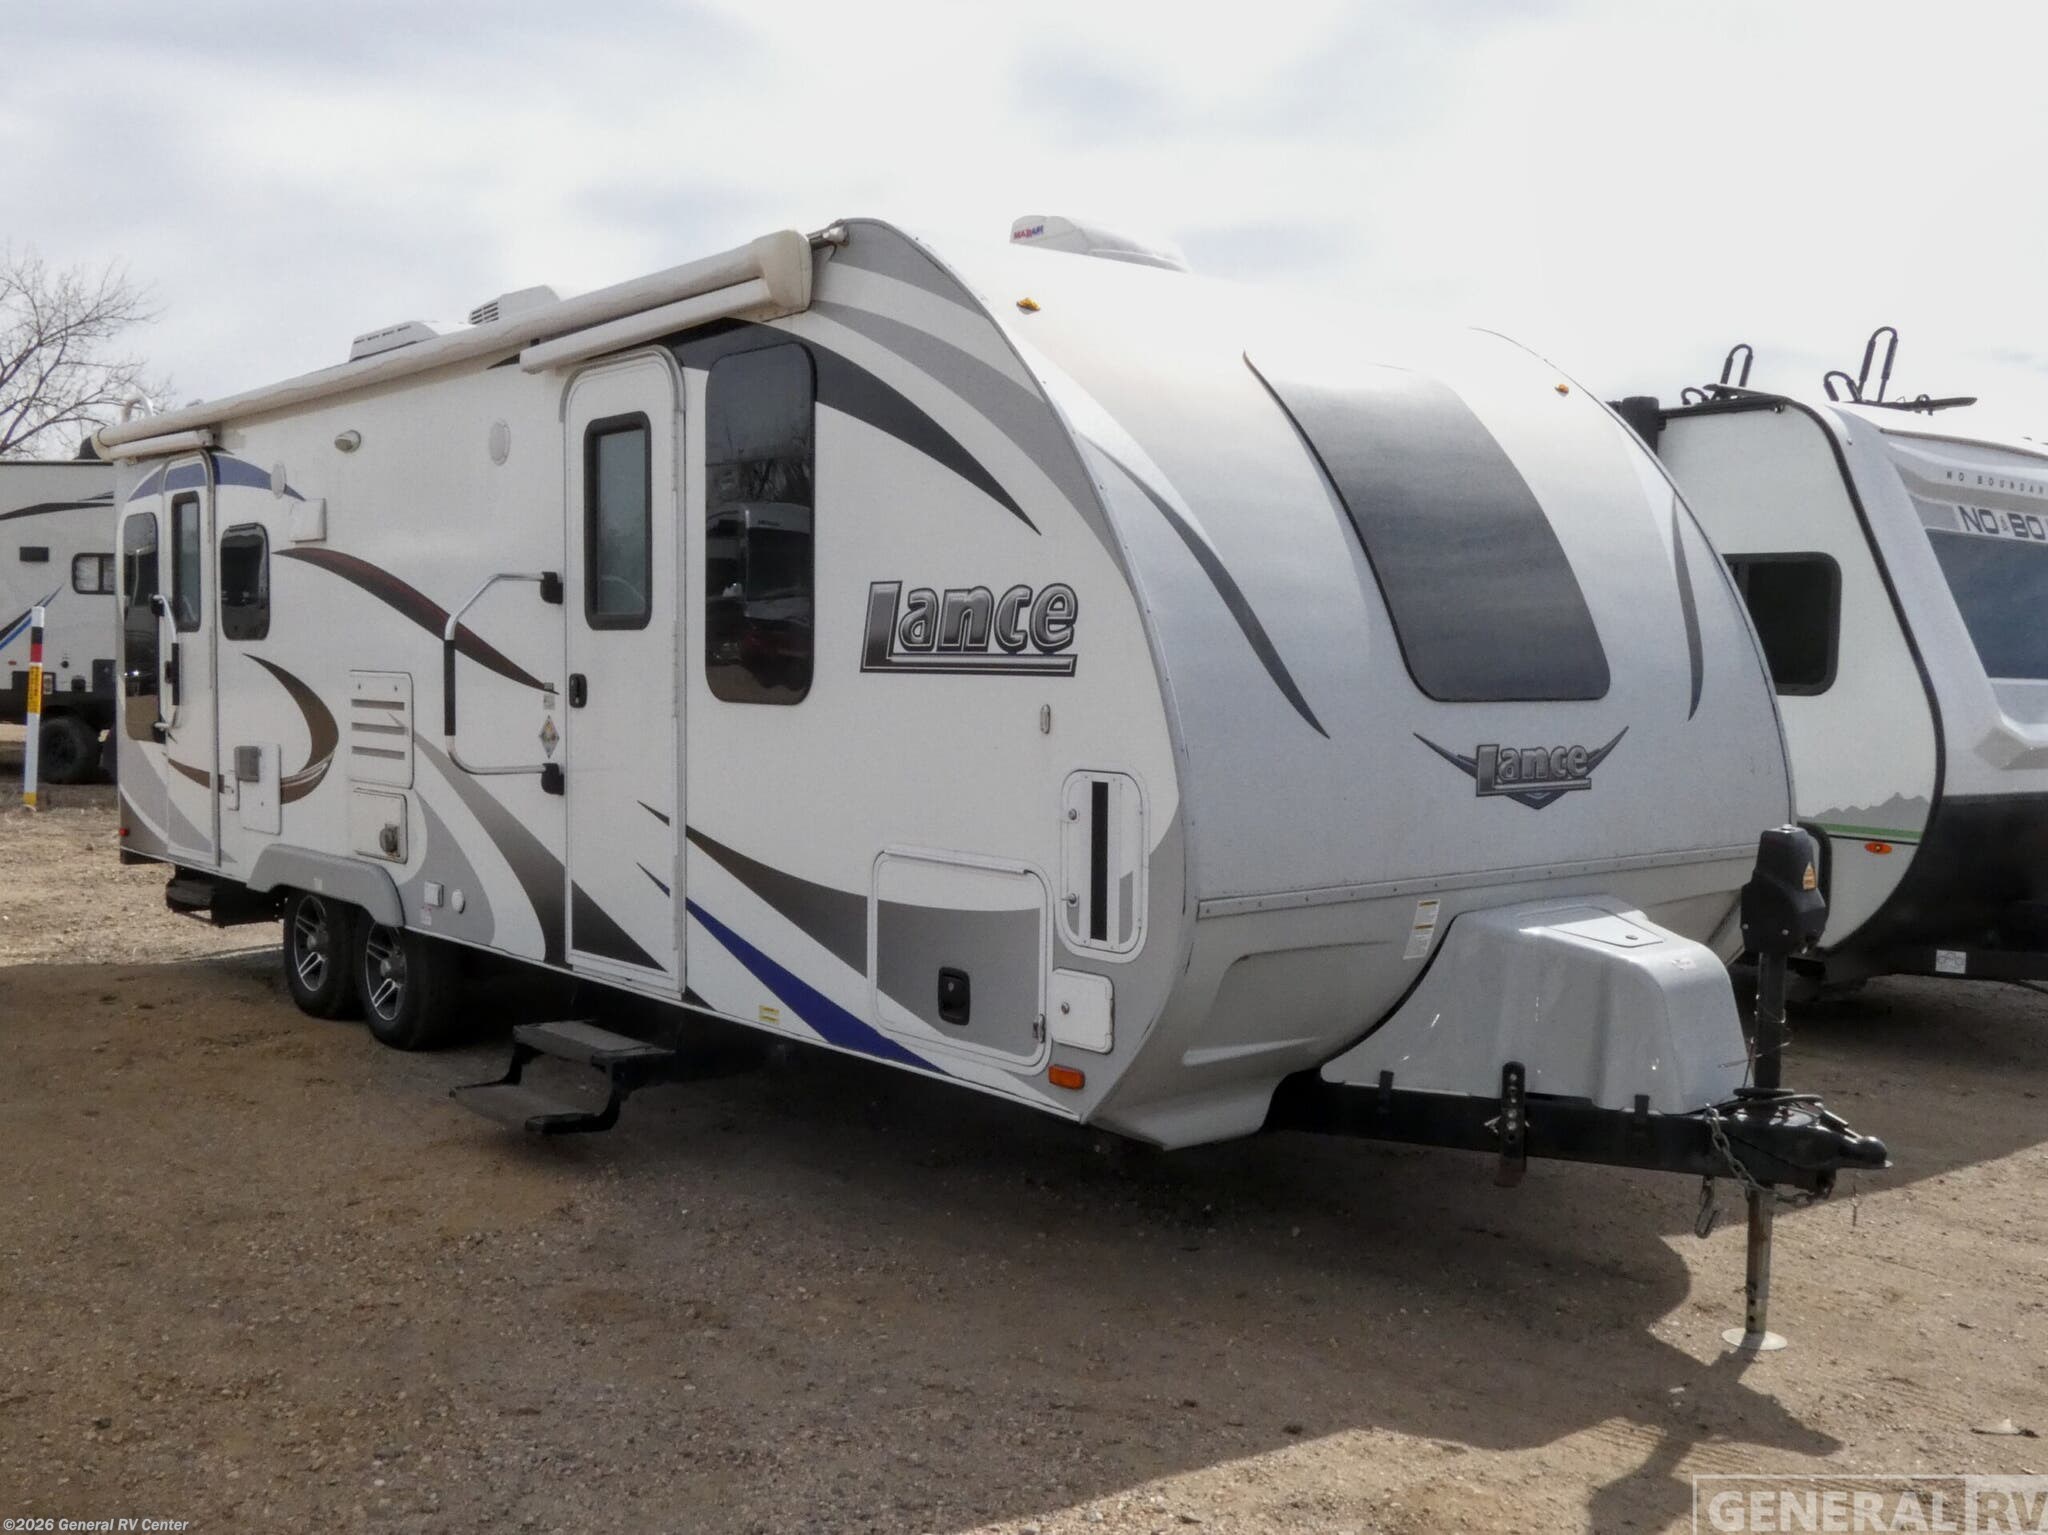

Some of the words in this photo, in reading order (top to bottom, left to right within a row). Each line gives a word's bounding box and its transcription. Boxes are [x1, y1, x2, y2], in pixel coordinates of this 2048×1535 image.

[1957, 505, 2000, 535] NO
[2007, 512, 2048, 541] BO
[860, 580, 1078, 677] Lance
[1476, 744, 1592, 797] Lance
